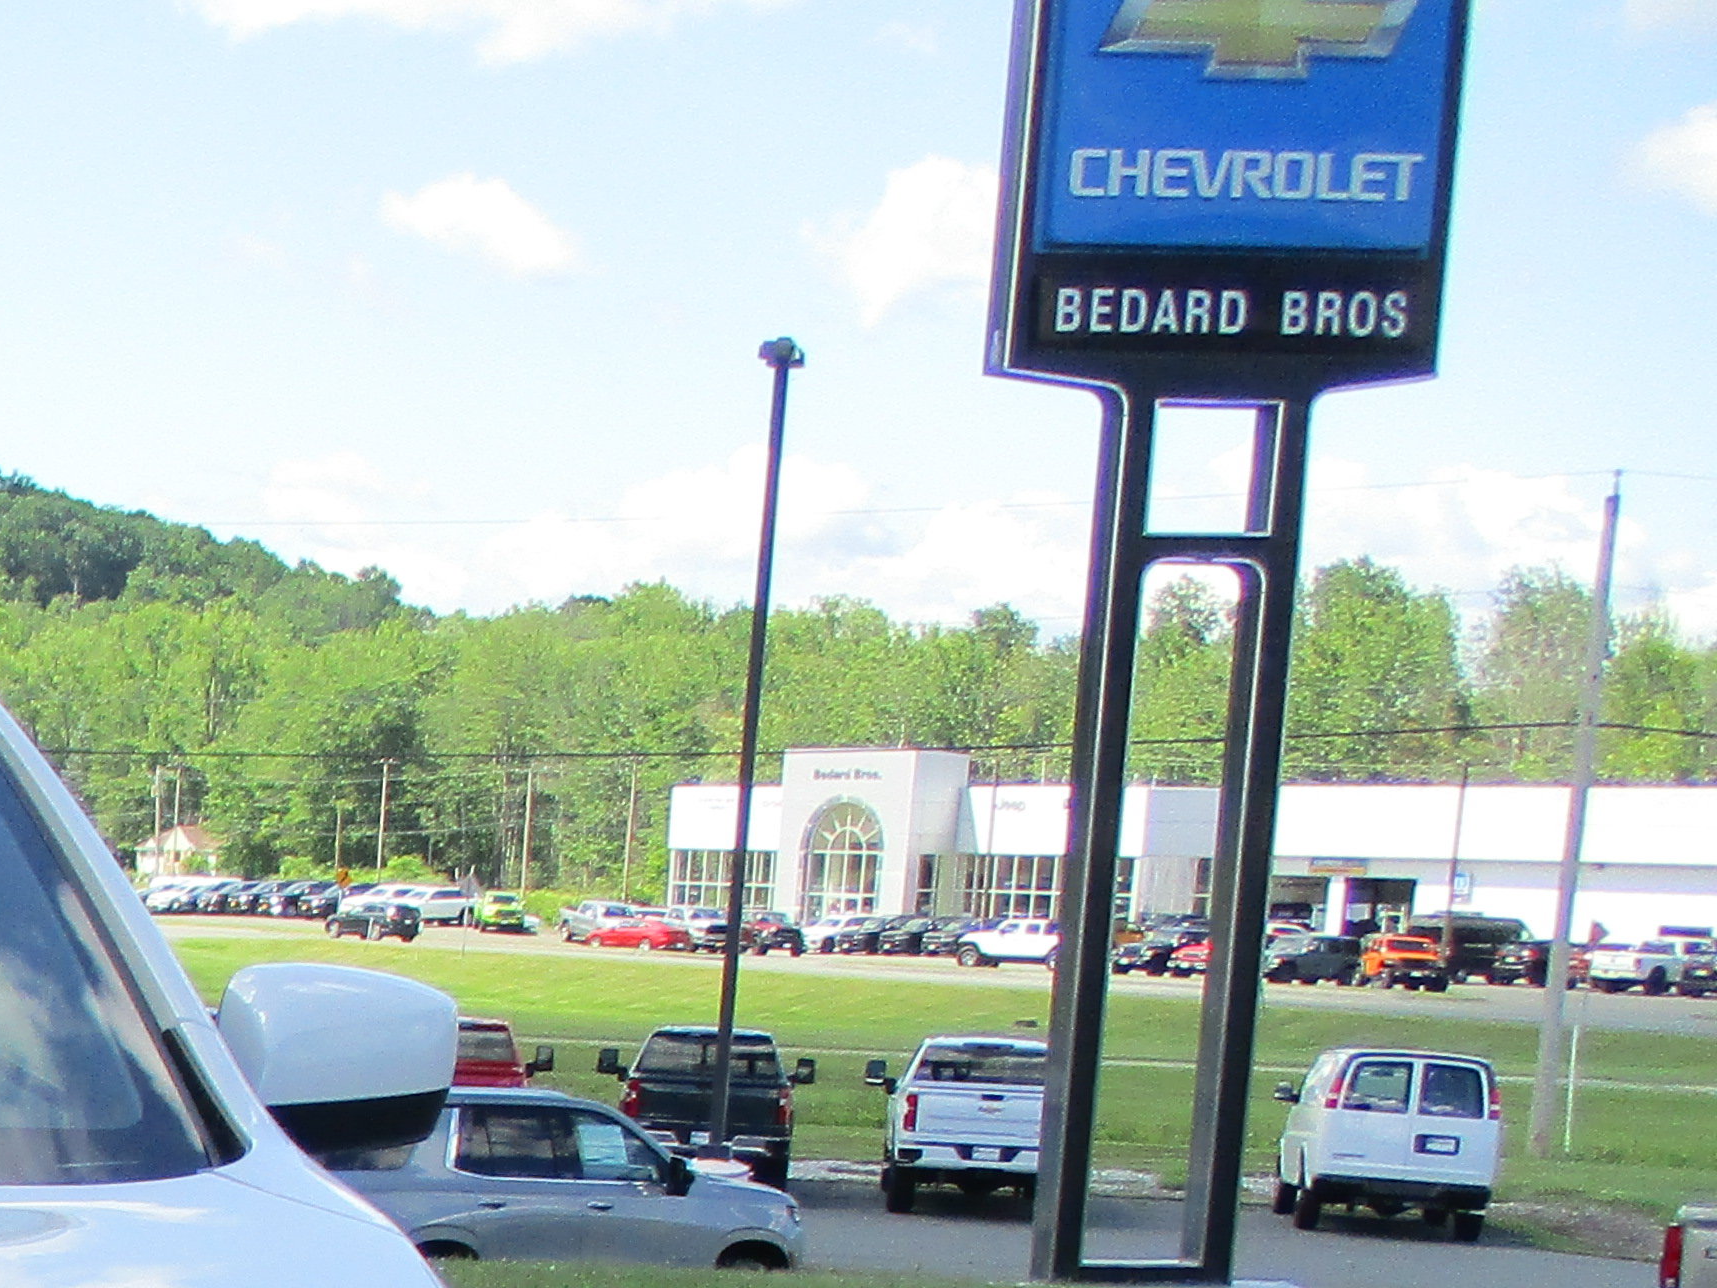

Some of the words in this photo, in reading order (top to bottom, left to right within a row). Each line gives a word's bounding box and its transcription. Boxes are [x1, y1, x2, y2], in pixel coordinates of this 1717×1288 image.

[1069, 147, 1426, 203] CHEVROLET
[1054, 286, 1248, 335] BEDARD
[1279, 289, 1408, 338] BROS
